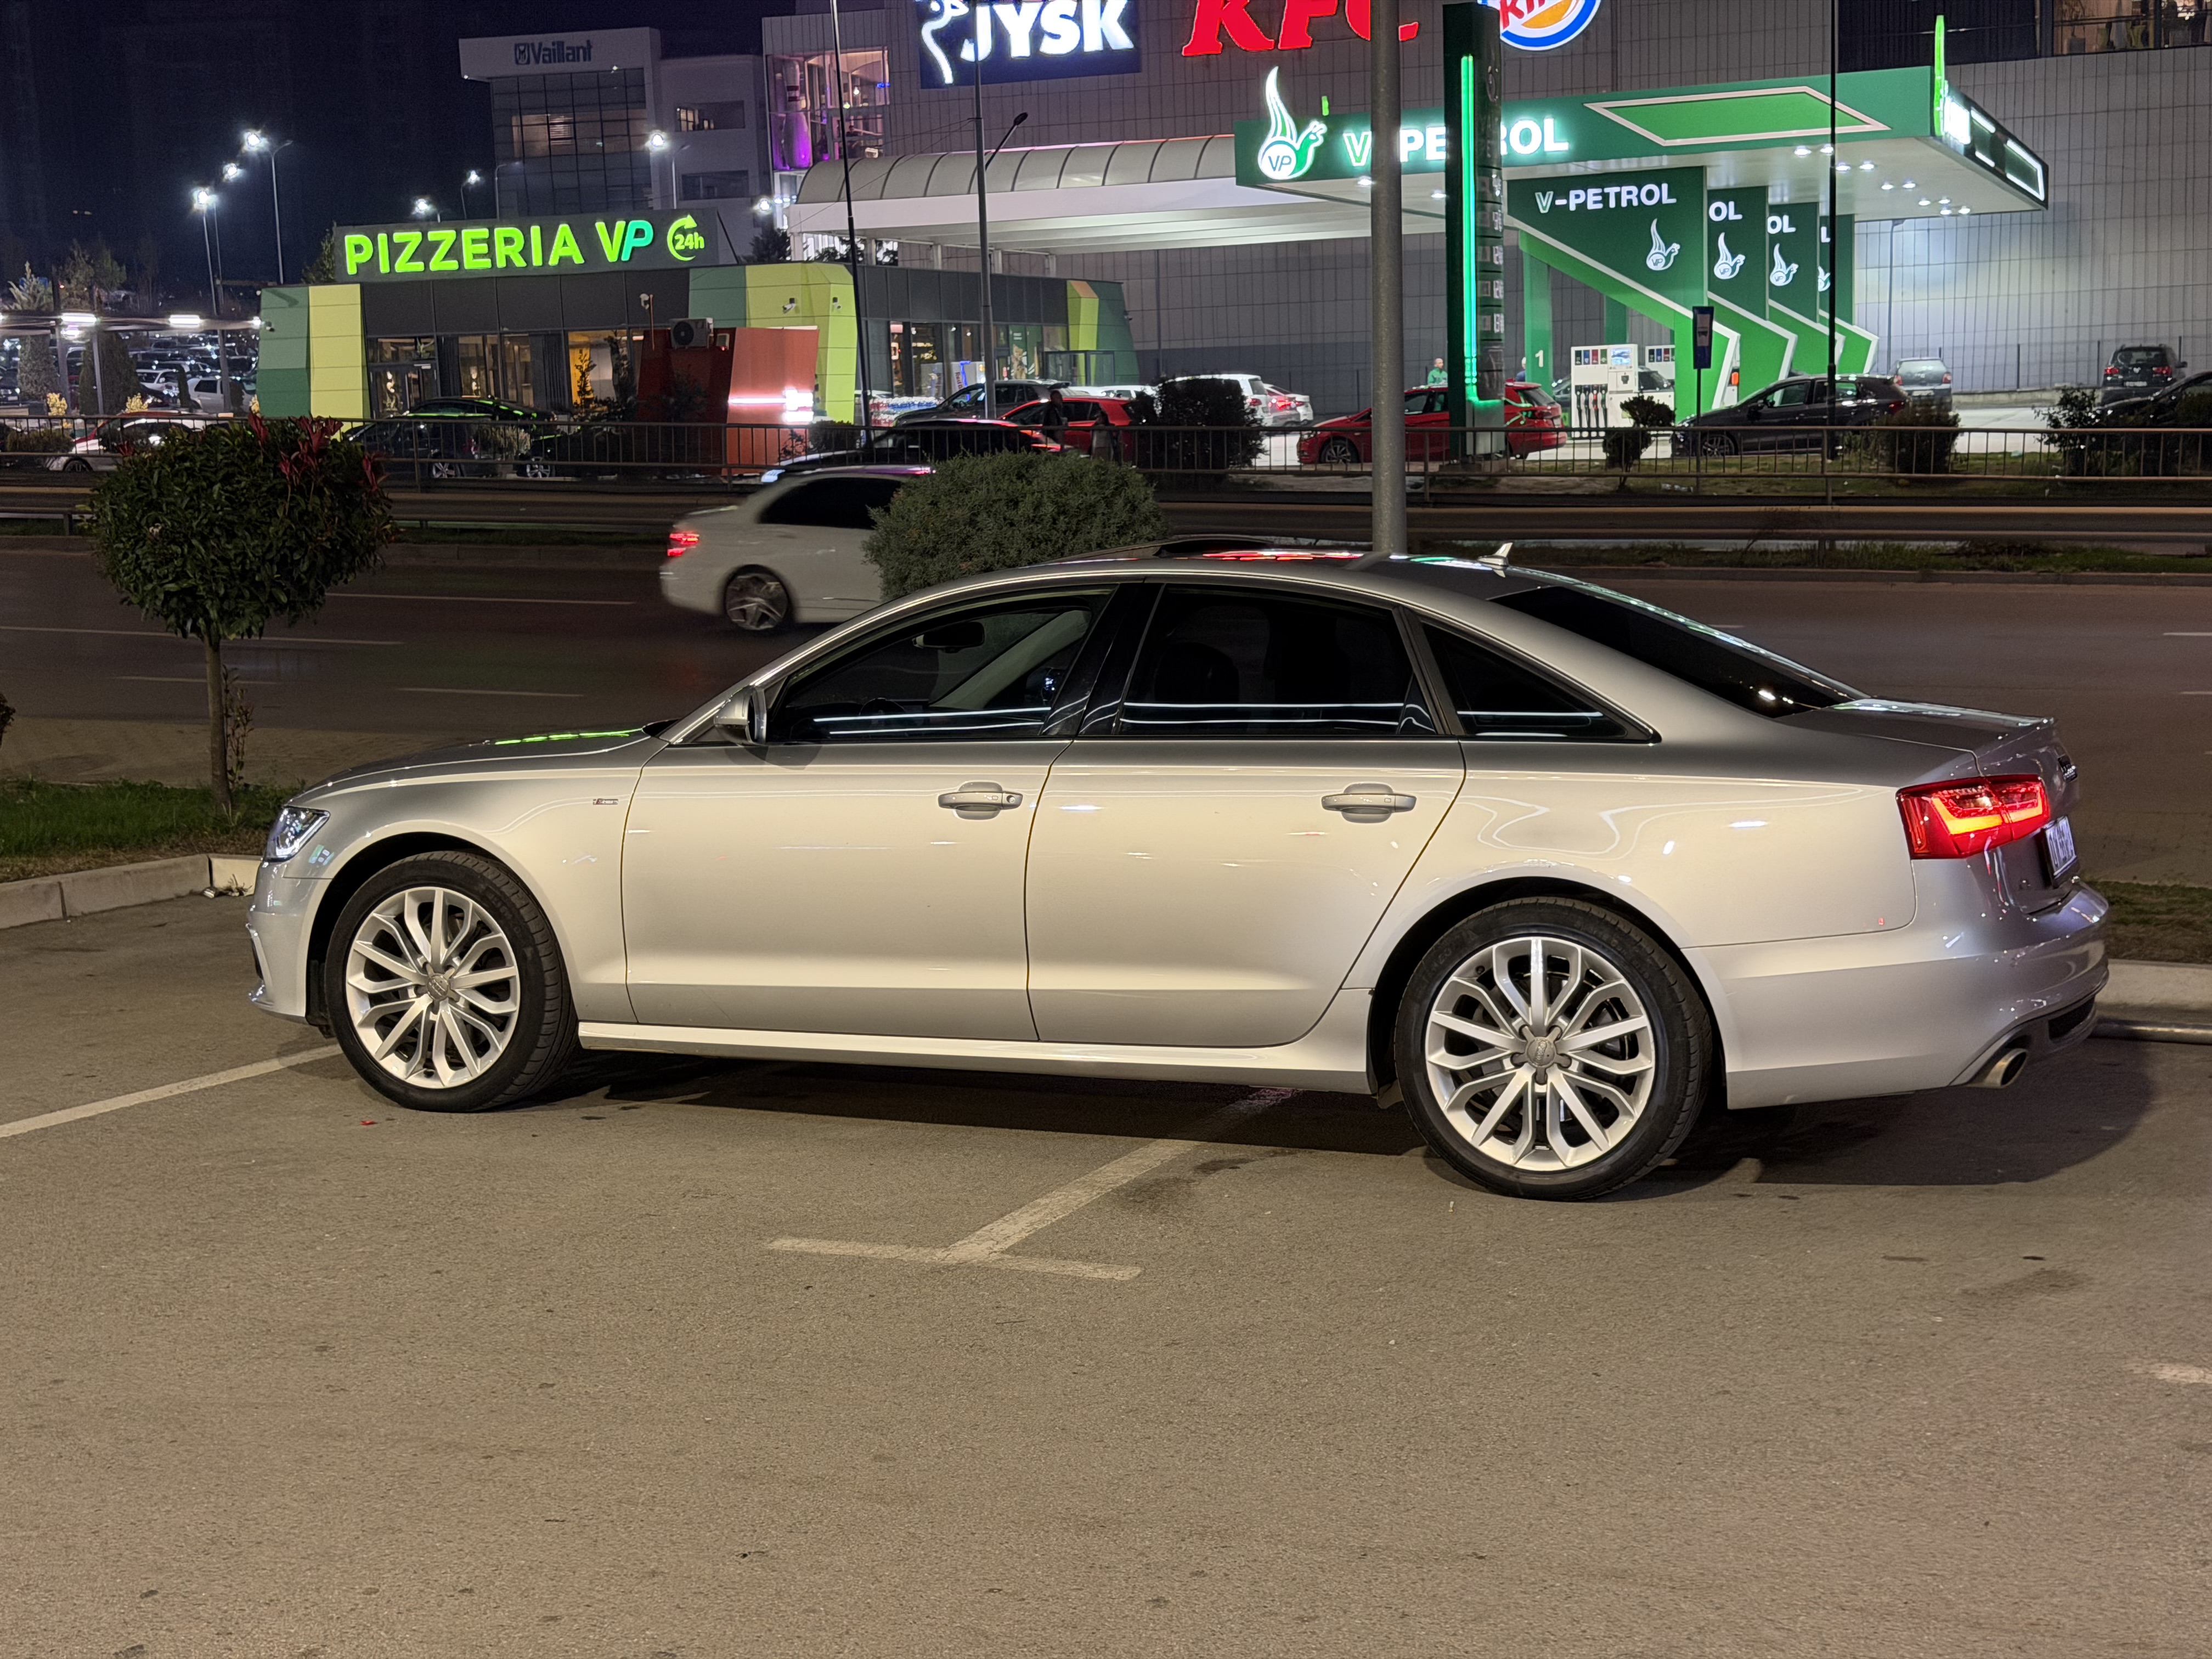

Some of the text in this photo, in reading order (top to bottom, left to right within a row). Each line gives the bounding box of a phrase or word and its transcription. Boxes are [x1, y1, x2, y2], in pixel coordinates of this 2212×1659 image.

[960, 0, 1135, 62] JYSK
[530, 39, 592, 65] Vaillant
[1267, 155, 1293, 172] VP
[1535, 183, 1677, 213] V-PETROL
[345, 220, 654, 274] PIZZERIA VP
[674, 231, 705, 250] 24h
[1534, 349, 1544, 368] 1
